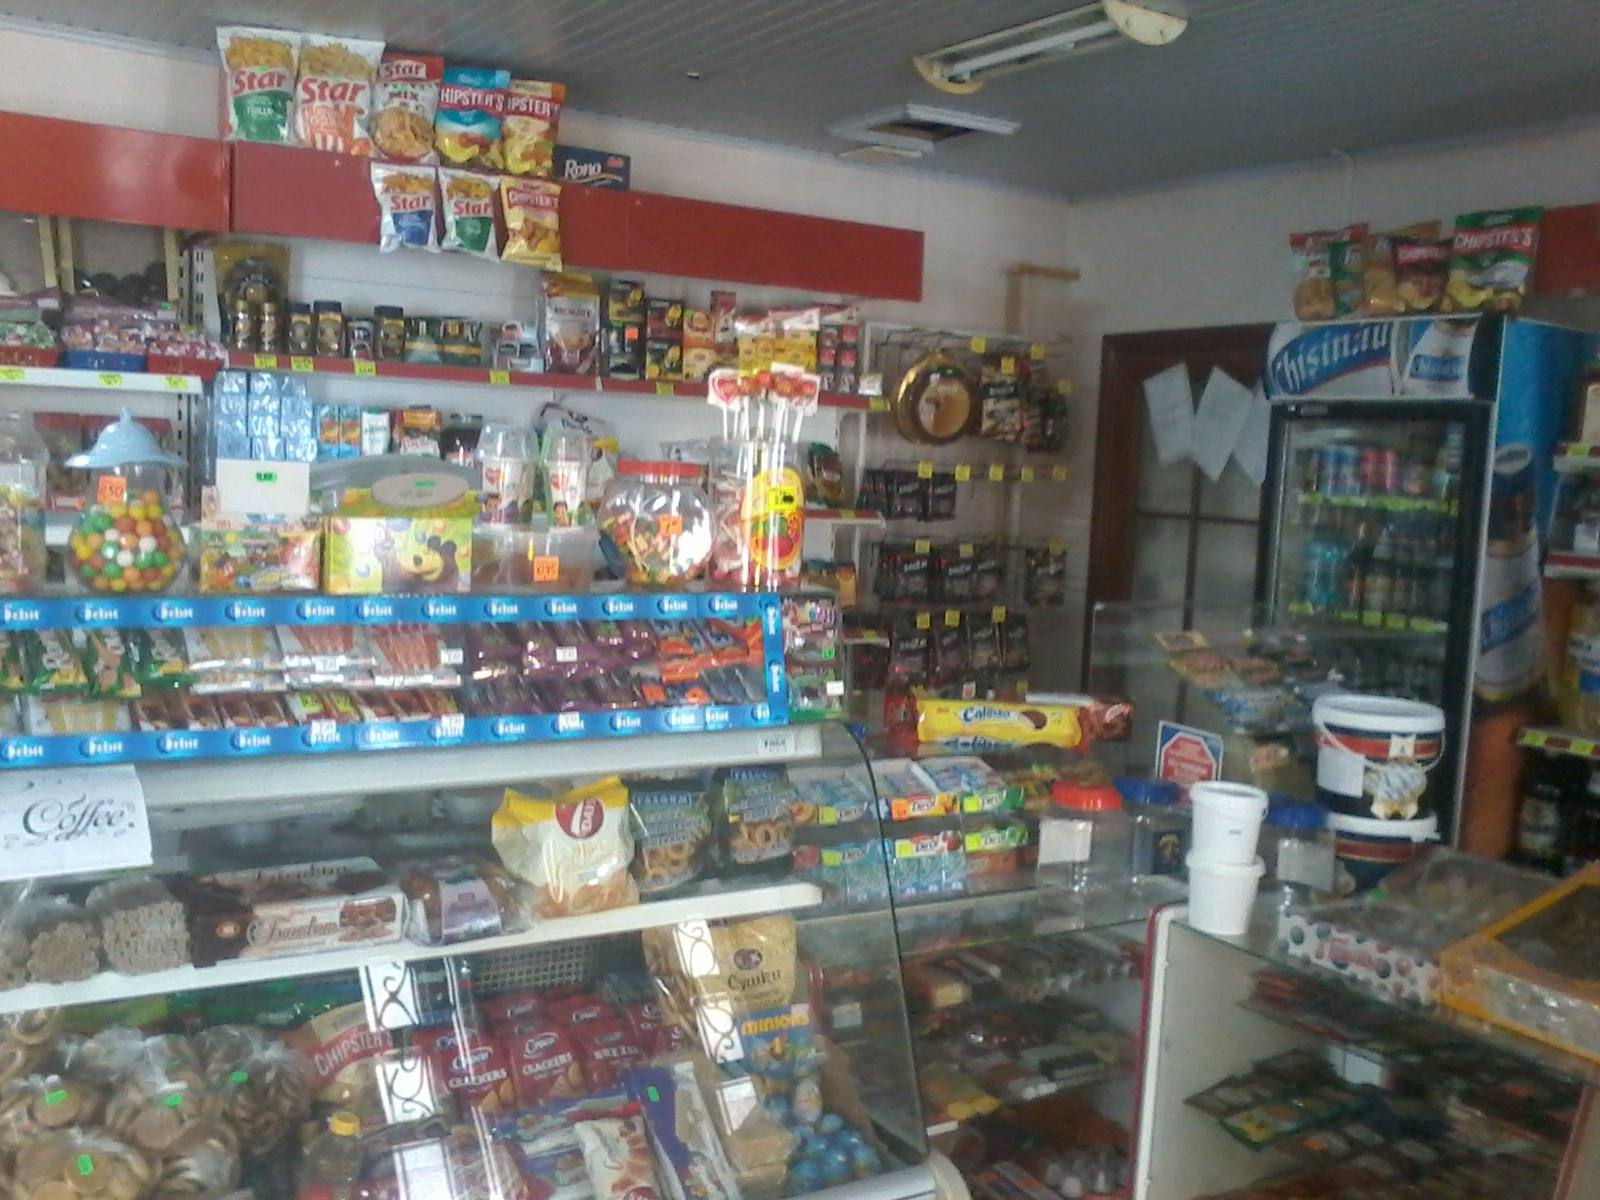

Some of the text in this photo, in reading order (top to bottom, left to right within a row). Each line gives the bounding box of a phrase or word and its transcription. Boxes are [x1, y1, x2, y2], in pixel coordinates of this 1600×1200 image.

[233, 71, 287, 96] Star
[301, 78, 366, 104] Star
[440, 87, 505, 113] HIPSTER'S
[390, 194, 430, 211] Star
[453, 201, 492, 216] Star
[23, 793, 125, 841] Coffee
[522, 1052, 574, 1076] CRACKERS
[448, 1067, 507, 1089] CRACKERS
